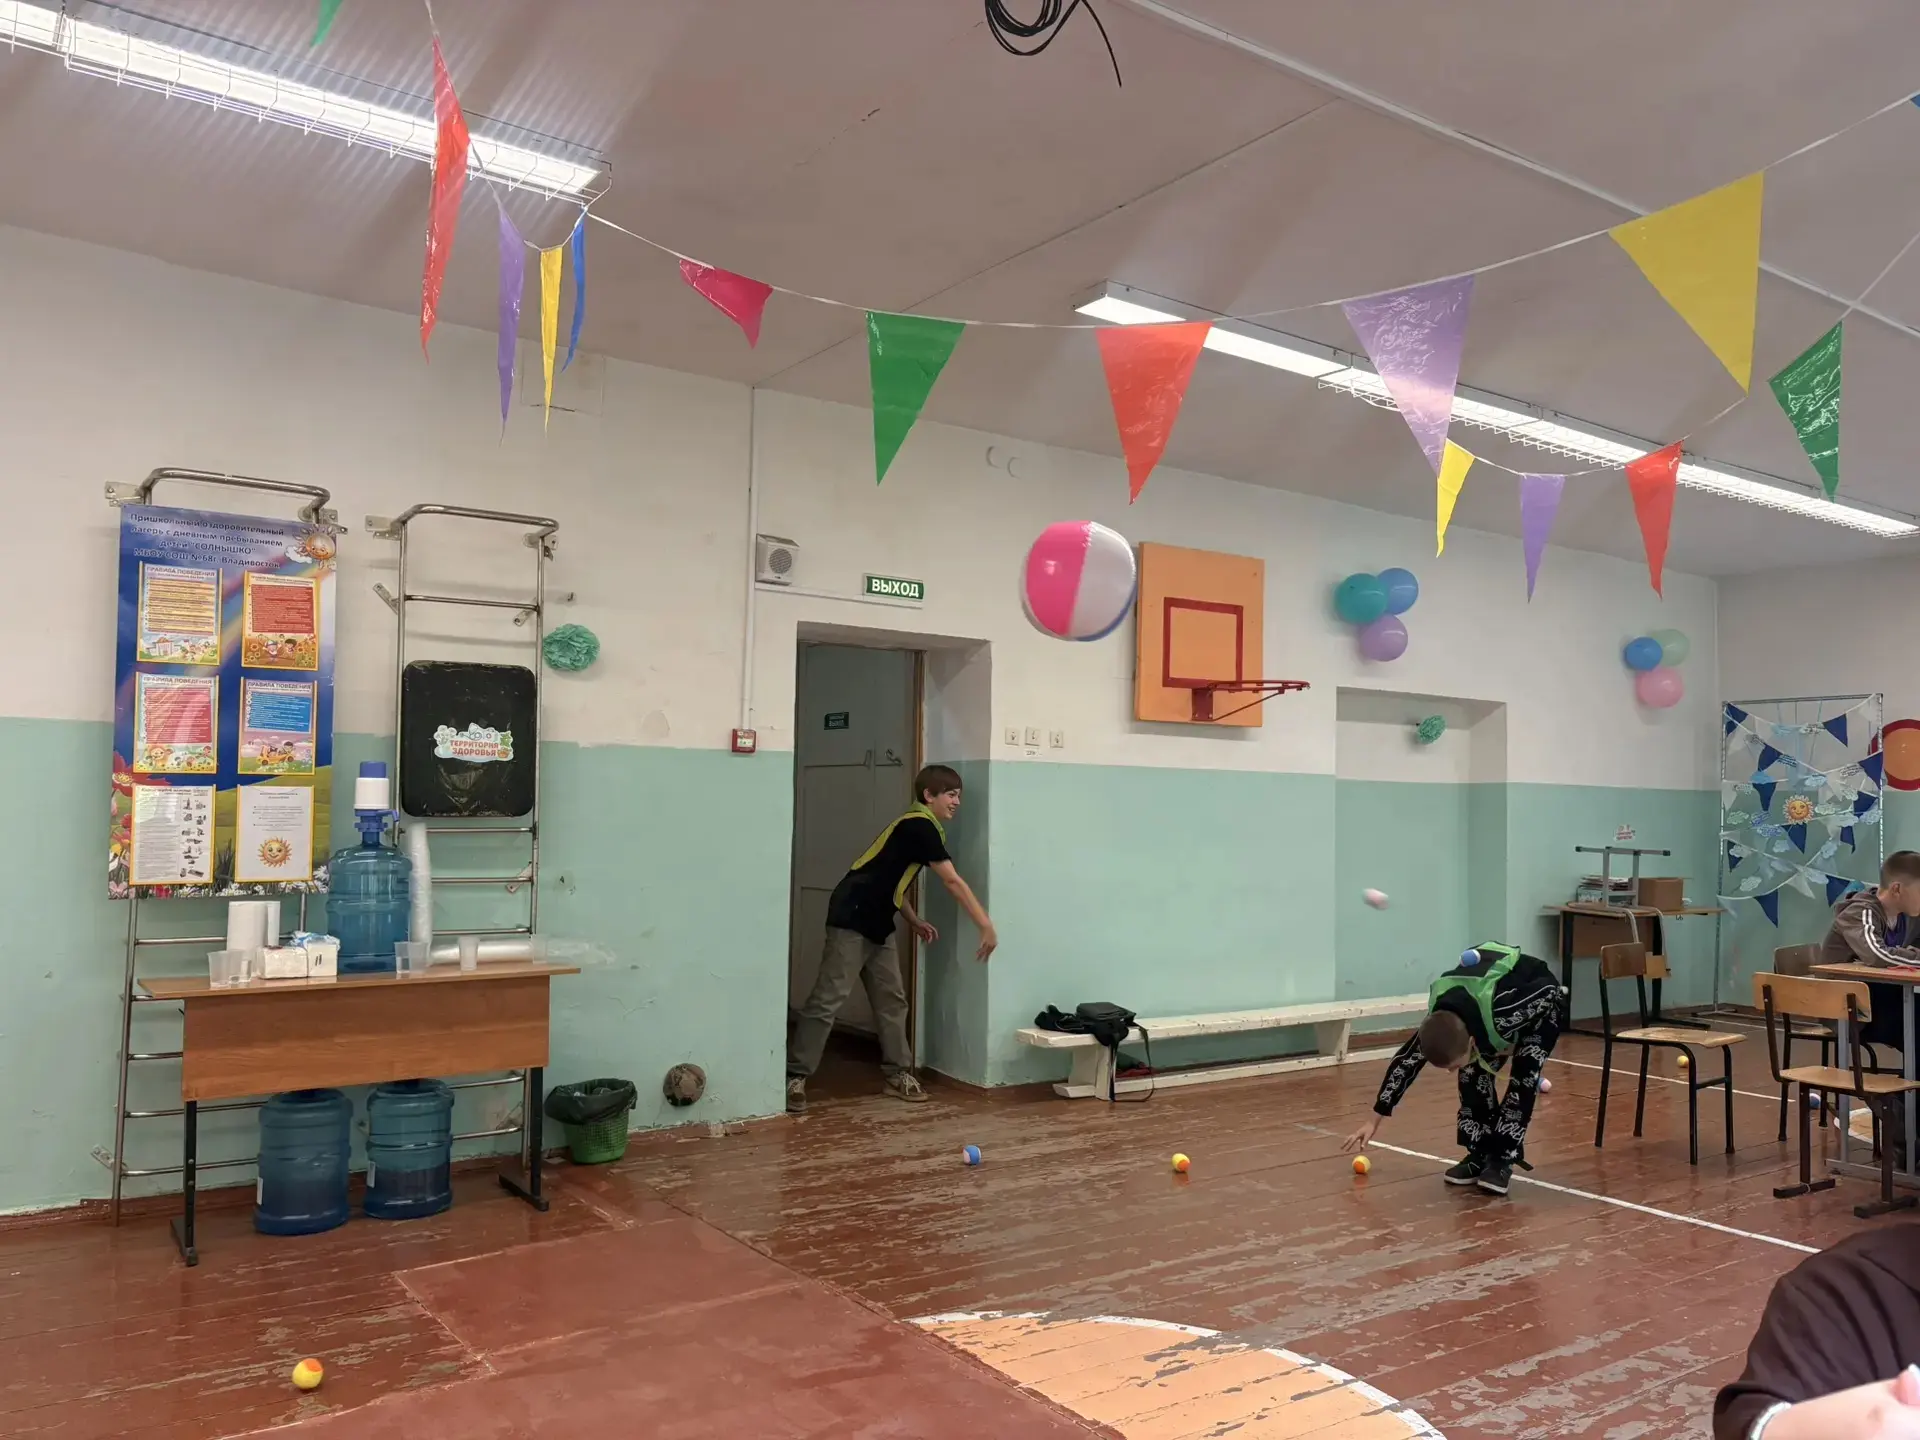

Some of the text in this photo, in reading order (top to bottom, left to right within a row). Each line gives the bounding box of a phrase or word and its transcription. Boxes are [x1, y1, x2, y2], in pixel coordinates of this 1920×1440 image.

[130, 513, 284, 536] Пришкольный оздоровительный
[131, 526, 164, 536] лагерь
[172, 530, 217, 540] дневным
[219, 534, 283, 547] пребыванием
[159, 540, 256, 555] детей "СОЛНЫШКО"
[133, 548, 164, 558] МБОУ
[165, 551, 190, 560] СОШ
[221, 556, 281, 569] Владивосток
[871, 578, 919, 598] ВЫХОД
[450, 740, 499, 749] ТЕРРИТОРИЯ
[452, 747, 496, 757] ЗДОРОВЬЯ
